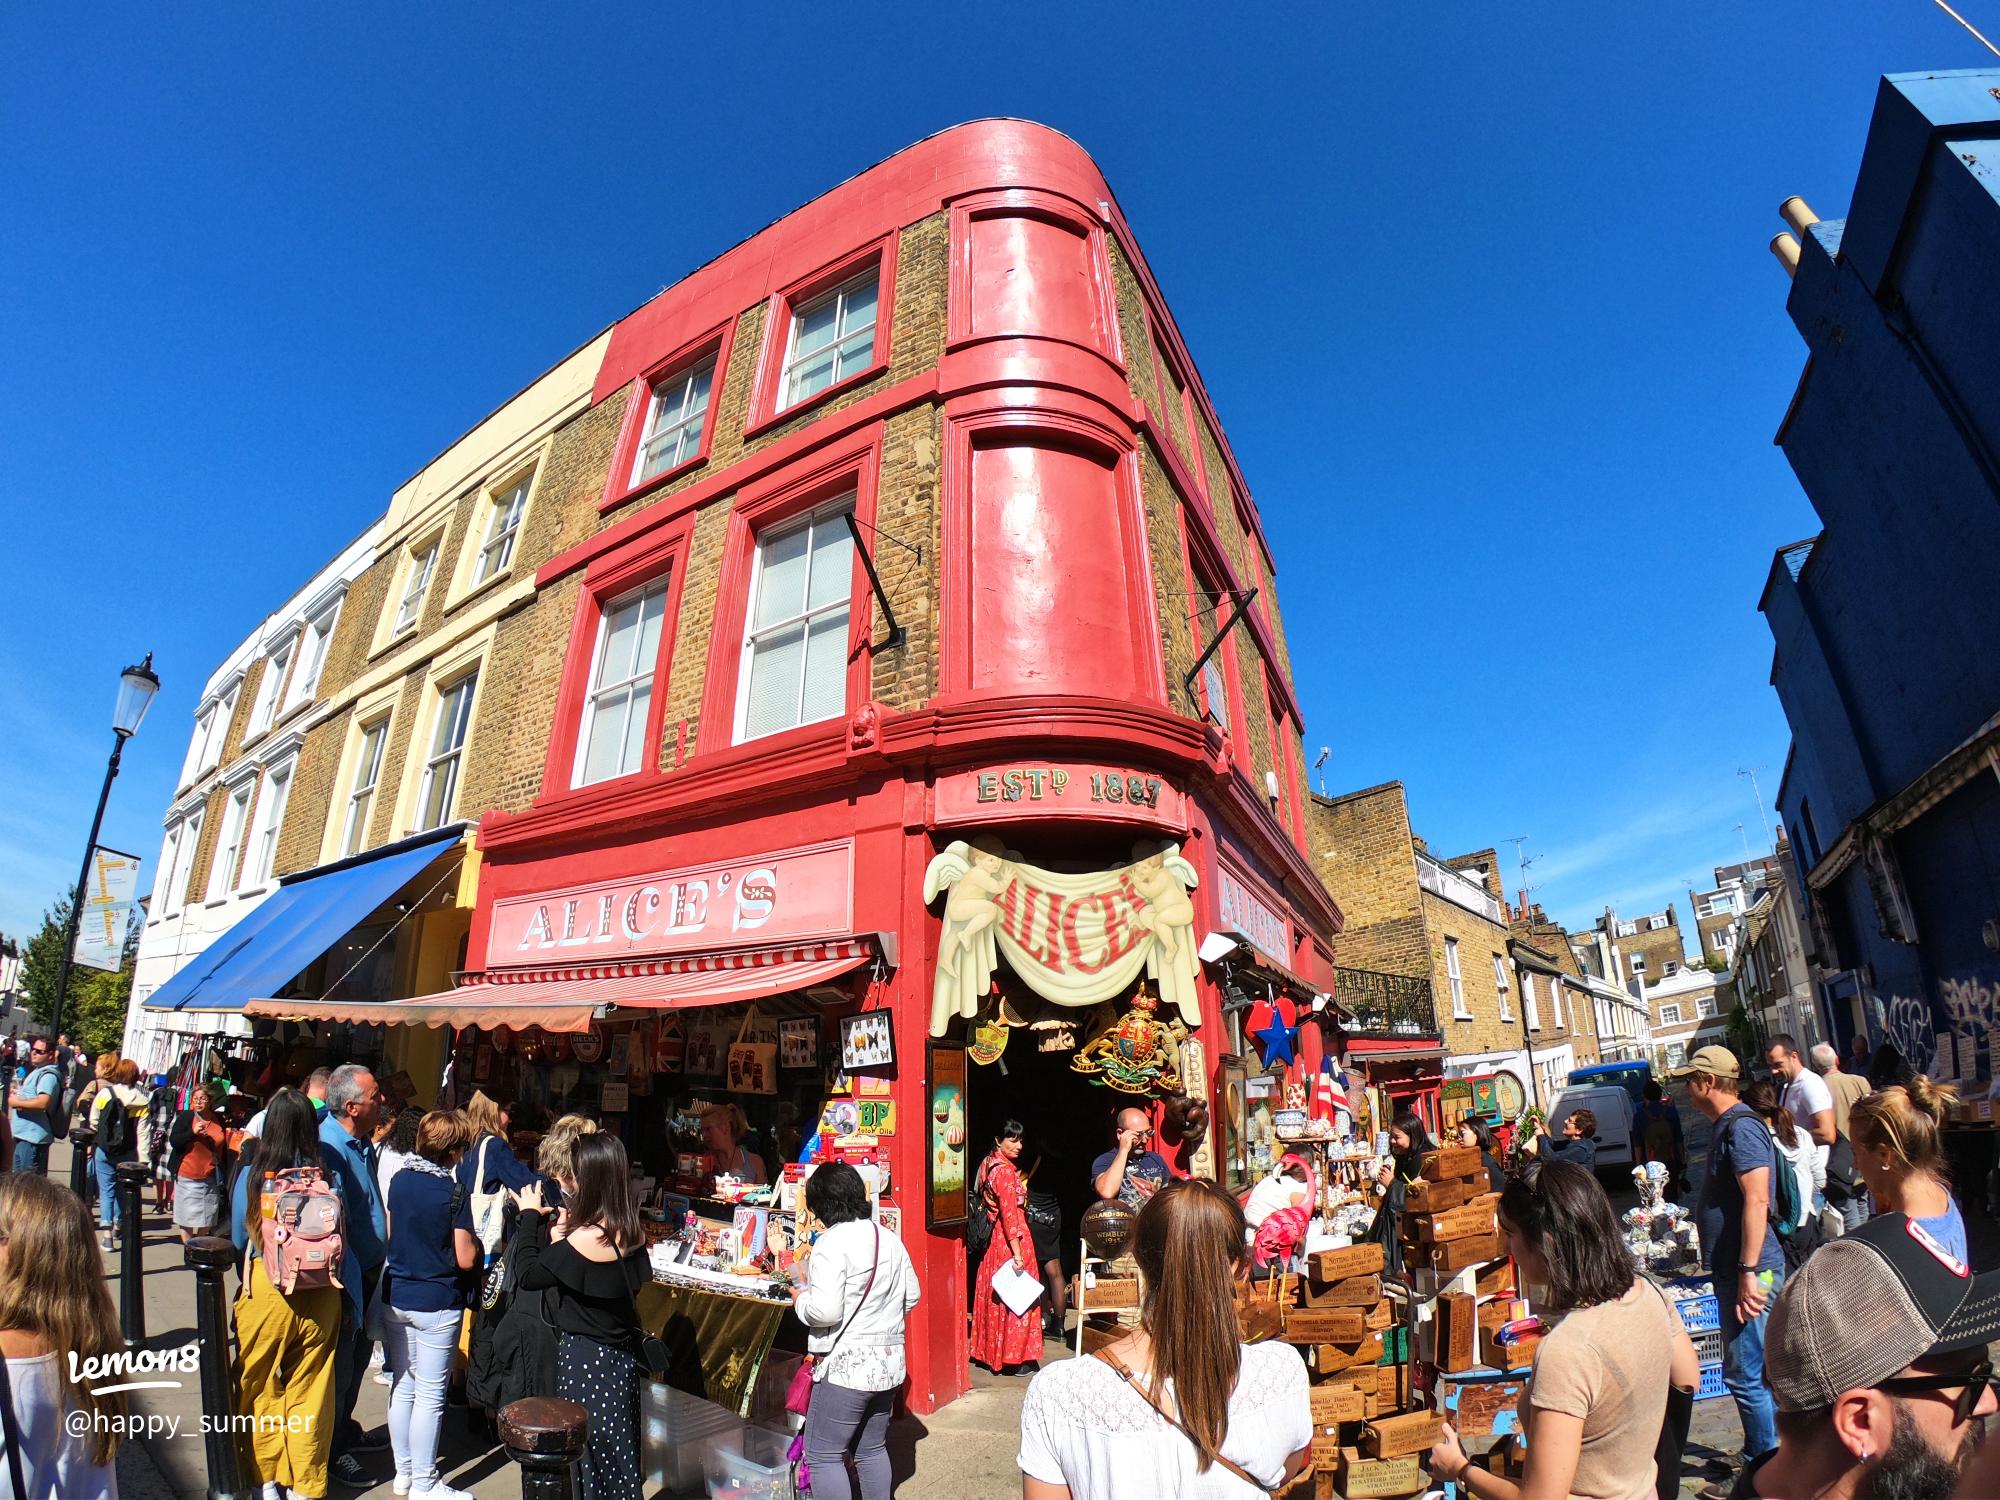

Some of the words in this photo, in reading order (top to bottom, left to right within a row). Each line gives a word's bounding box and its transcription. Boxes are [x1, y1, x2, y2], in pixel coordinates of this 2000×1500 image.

[1090, 772, 1162, 809] 1887
[517, 864, 778, 951] ALICE'S
[861, 1102, 889, 1127] BP
[1097, 1231, 1127, 1239] WEMBLEY
[1360, 1465, 1379, 1473] JACK
